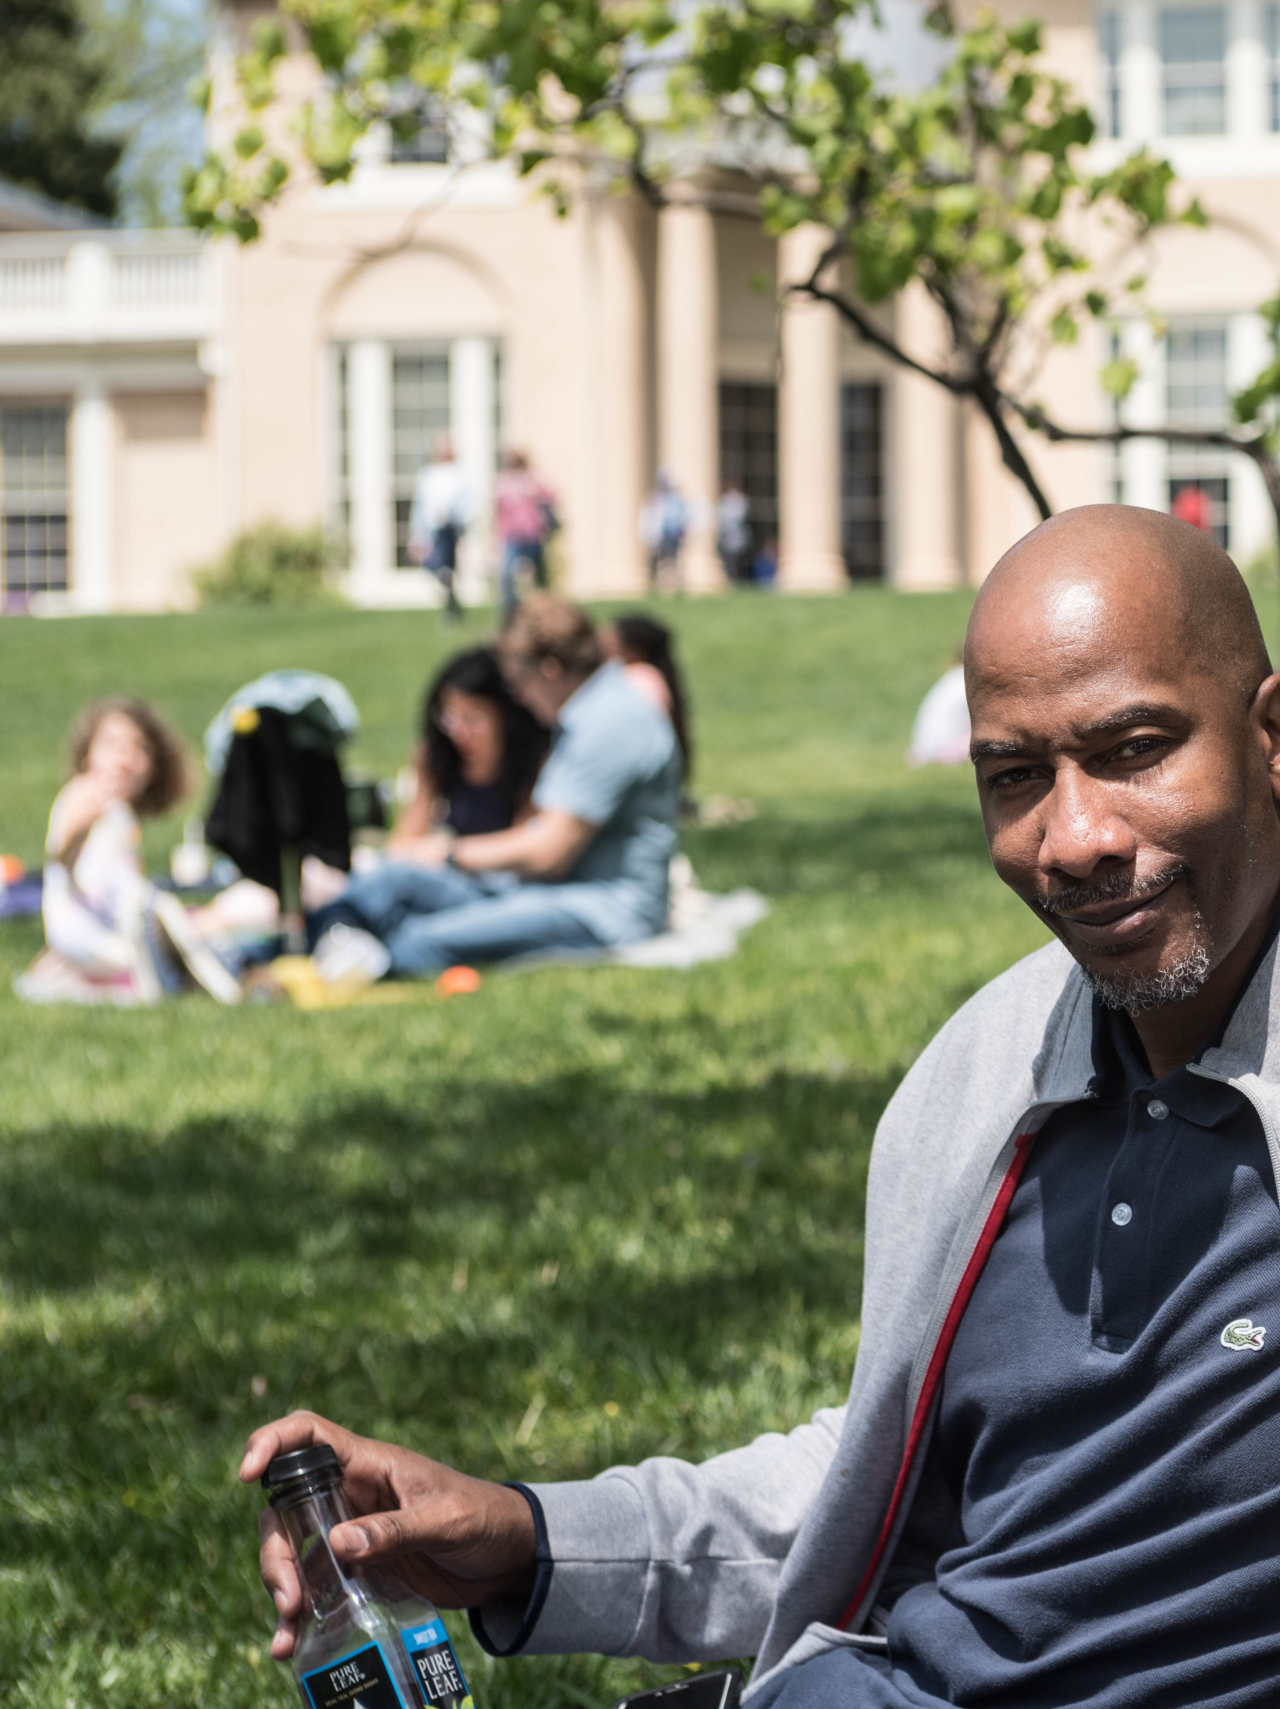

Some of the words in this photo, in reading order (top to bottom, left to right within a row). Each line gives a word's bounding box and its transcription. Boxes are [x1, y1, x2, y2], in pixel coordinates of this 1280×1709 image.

[329, 1661, 360, 1679] PURE
[416, 1650, 454, 1679] PURE
[424, 1670, 460, 1700] LEAF
